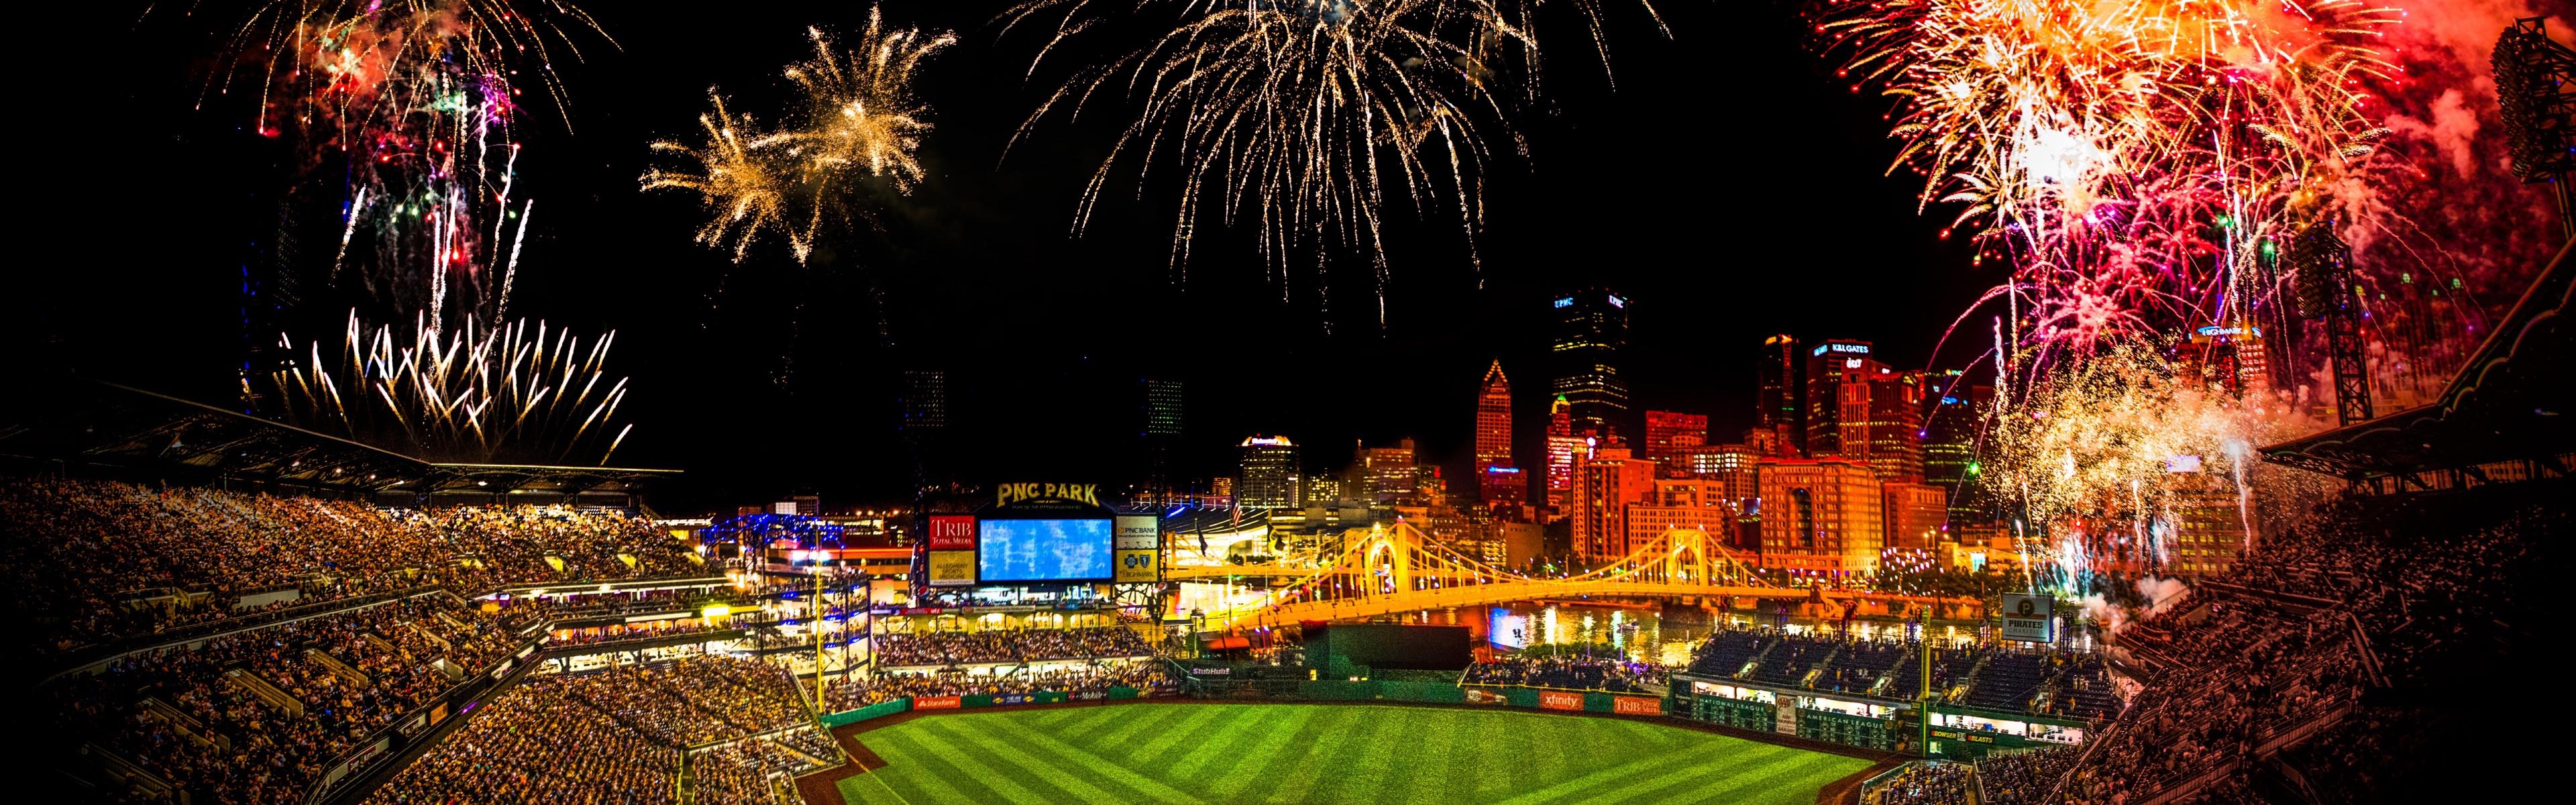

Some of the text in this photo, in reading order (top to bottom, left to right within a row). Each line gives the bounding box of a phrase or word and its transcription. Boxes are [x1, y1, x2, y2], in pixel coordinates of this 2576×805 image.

[2200, 327, 2243, 336] HIGHMARK
[1846, 345, 1869, 354] GATES
[996, 482, 1100, 508] PNC PARK
[931, 519, 971, 537] TRIB
[932, 537, 952, 545] TOTAL
[2023, 603, 2031, 614] P
[2008, 620, 2043, 629] PIRATES
[1546, 694, 1578, 708] xfinity
[1615, 699, 1641, 712] TRIB
[1699, 698, 1735, 708] NATIONAL
[1737, 703, 1764, 712] LEAGUE
[1807, 714, 1849, 724] AMERICAN
[1851, 720, 1884, 729] LEAGUE
[1934, 731, 1957, 739] BOWSER
[1971, 735, 1993, 743] BLASTS
